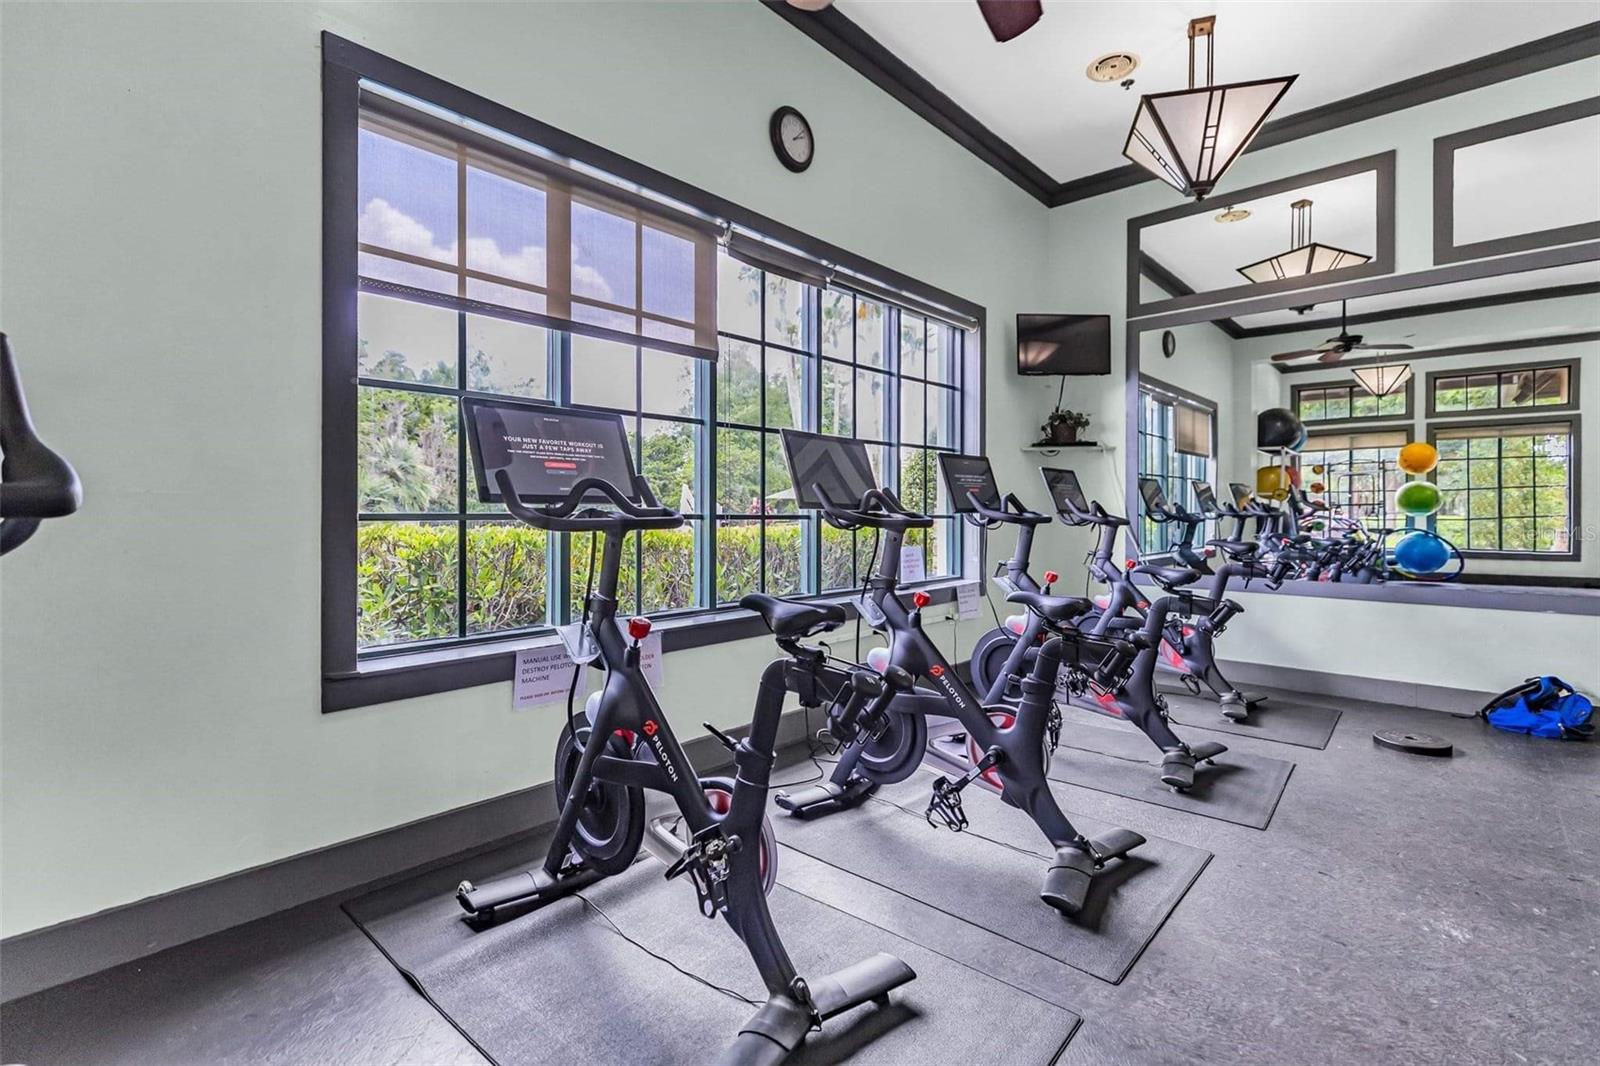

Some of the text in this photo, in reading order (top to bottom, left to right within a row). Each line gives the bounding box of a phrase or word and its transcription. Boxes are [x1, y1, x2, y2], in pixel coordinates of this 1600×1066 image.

[503, 435, 522, 443] YOUR
[539, 438, 568, 447] FAVORITE
[568, 441, 597, 449] WORKOUT
[522, 655, 549, 666] MANUAL
[550, 653, 563, 662] USE
[521, 665, 549, 675] DESTROY
[521, 674, 550, 685] MACHINE
[940, 675, 966, 708] PELOTON
[652, 735, 679, 782] PELOTON
